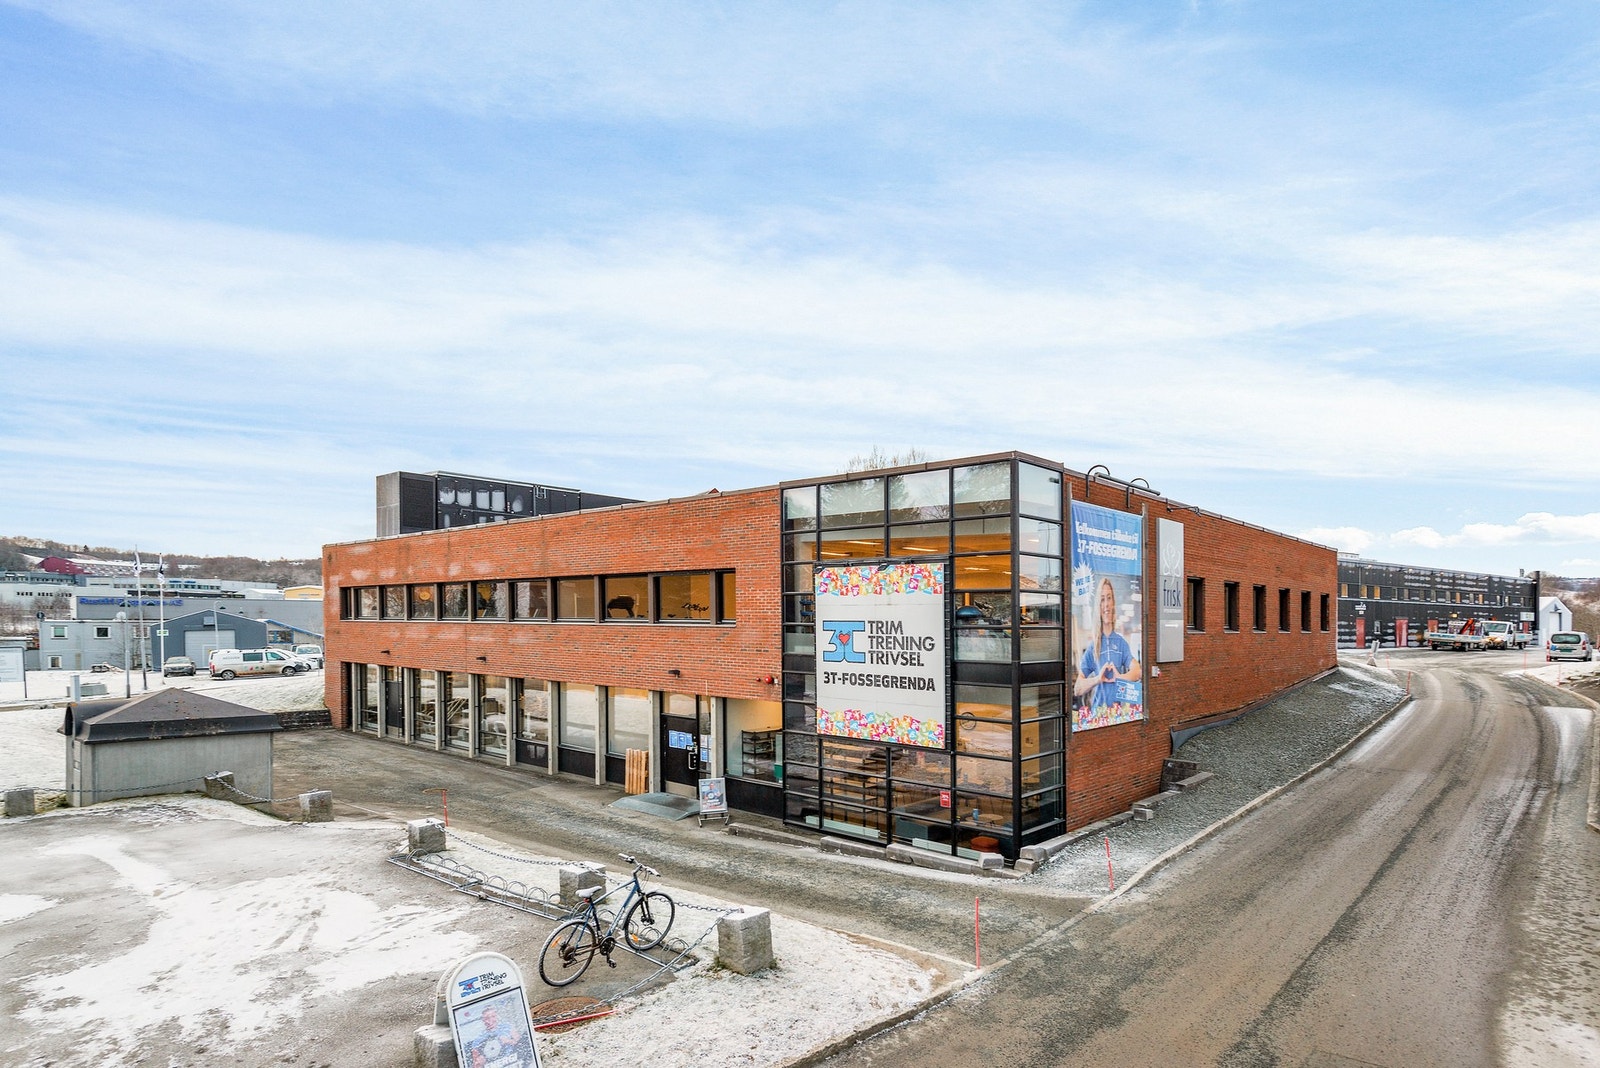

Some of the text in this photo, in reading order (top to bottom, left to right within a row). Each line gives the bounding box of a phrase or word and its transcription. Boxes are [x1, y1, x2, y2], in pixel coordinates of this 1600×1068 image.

[1163, 579, 1181, 607] frisk
[868, 620, 904, 635] TRIM
[868, 635, 936, 652] TRENING
[868, 650, 925, 666] TRIVSEL
[823, 671, 936, 692] 3T-FOSSEGRENDA
